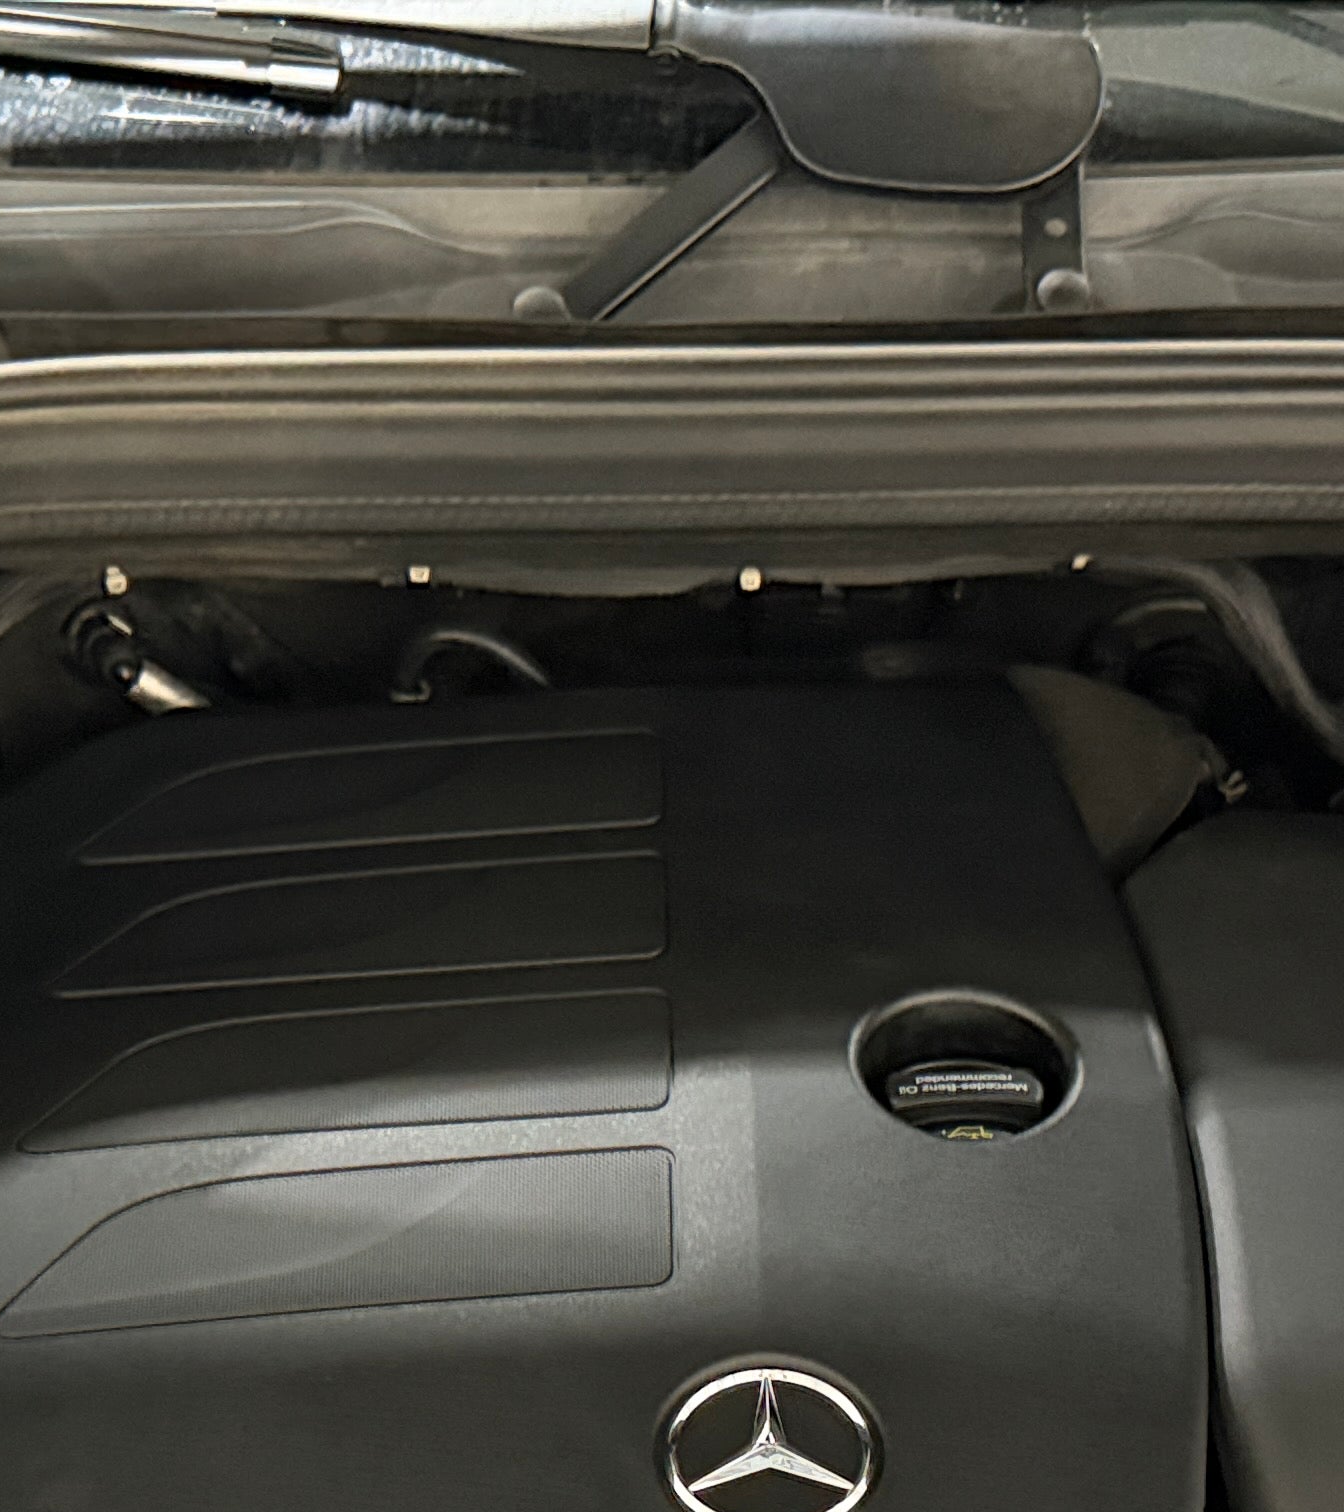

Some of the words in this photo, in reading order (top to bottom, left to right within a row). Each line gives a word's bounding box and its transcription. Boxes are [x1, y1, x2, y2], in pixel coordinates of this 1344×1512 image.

[915, 1073, 1012, 1084] recommended
[899, 1085, 918, 1095] Oil
[922, 1082, 1028, 1093] Mercedes-Benz
